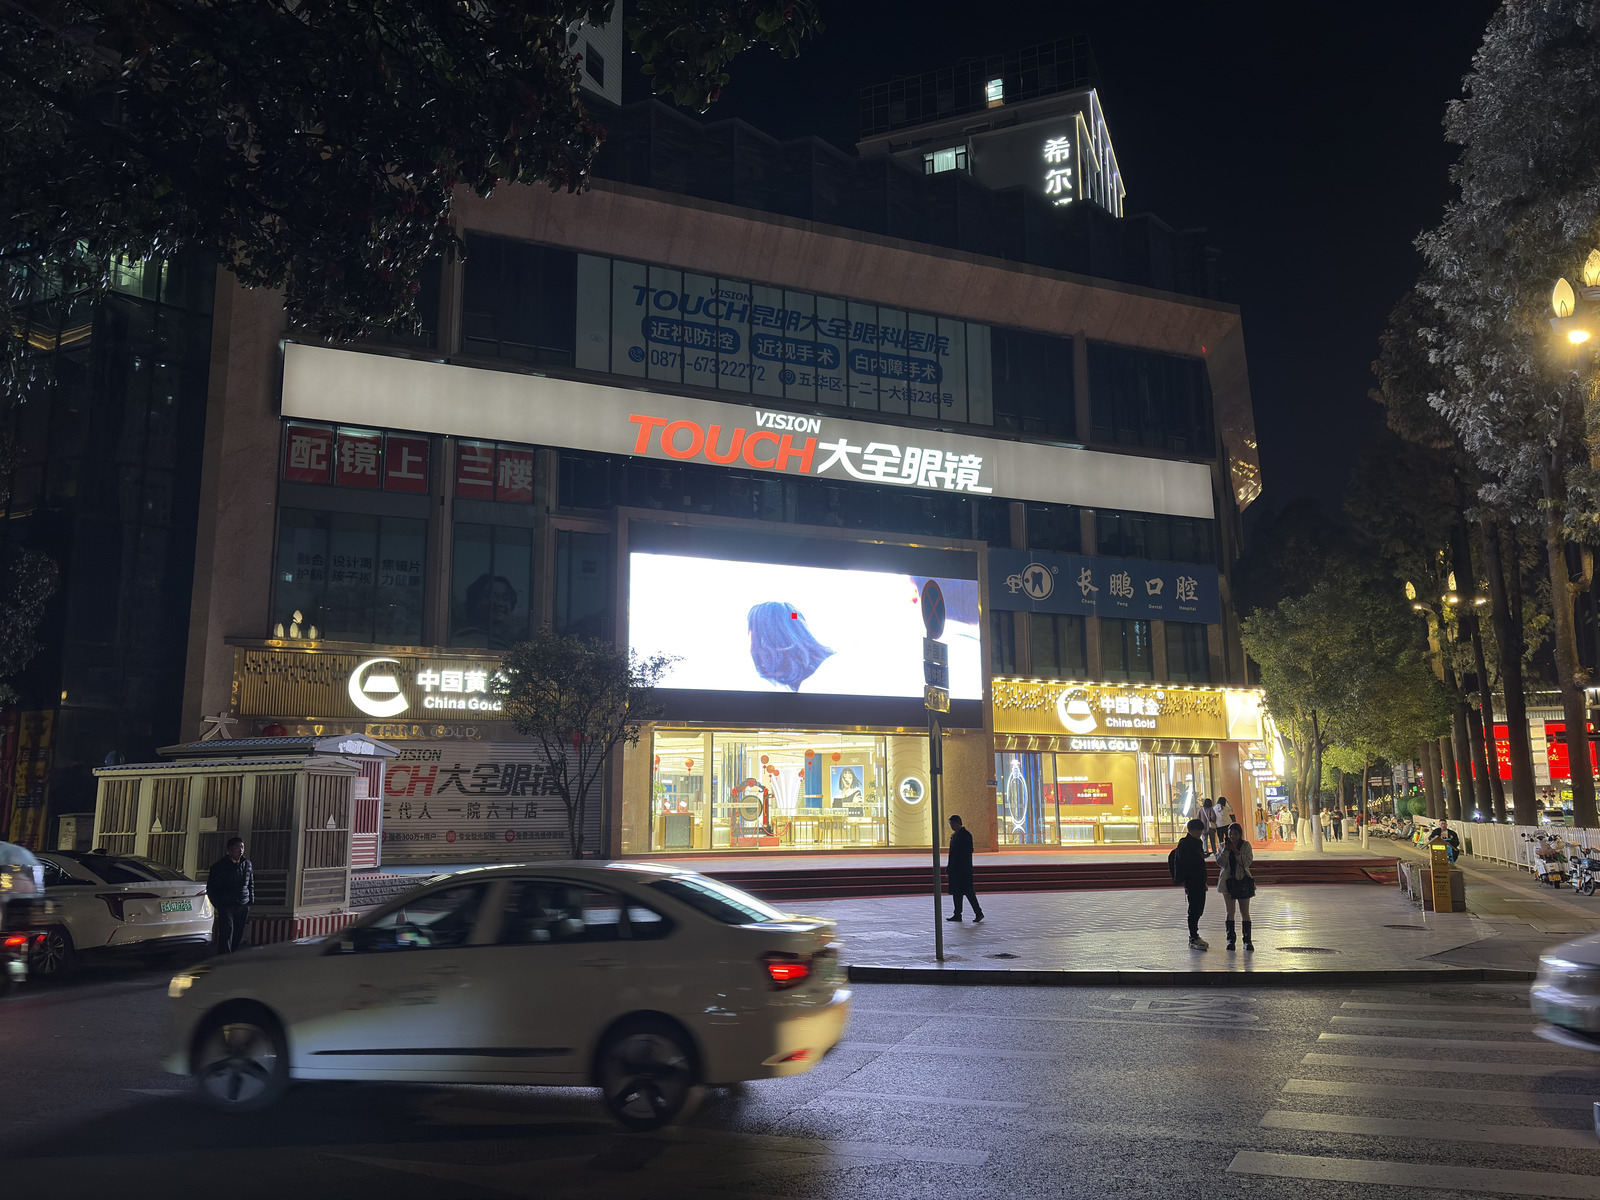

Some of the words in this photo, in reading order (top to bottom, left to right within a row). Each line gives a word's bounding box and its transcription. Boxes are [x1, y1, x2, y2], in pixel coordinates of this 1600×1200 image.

[1044, 136, 1073, 206] 希尔
[631, 284, 751, 325] TOUCH
[709, 287, 753, 302] VISION
[650, 320, 735, 350] 近视防控
[757, 338, 835, 366] 近视手术
[854, 352, 938, 382] 白内障手术
[755, 411, 822, 434] VISION
[628, 413, 818, 474] TOUCH
[816, 438, 993, 494] 大全眼镜
[1076, 567, 1199, 602] 长鹏口腔
[1081, 598, 1096, 606] Chang
[424, 696, 466, 710] China
[1100, 696, 1160, 716] 中国黄金
[370, 724, 425, 737] CHINA
[430, 725, 476, 737] GOLD
[1105, 717, 1133, 728] China
[1133, 718, 1156, 728] Gold
[1070, 738, 1107, 751] CHINA
[1107, 739, 1139, 751] GOLD
